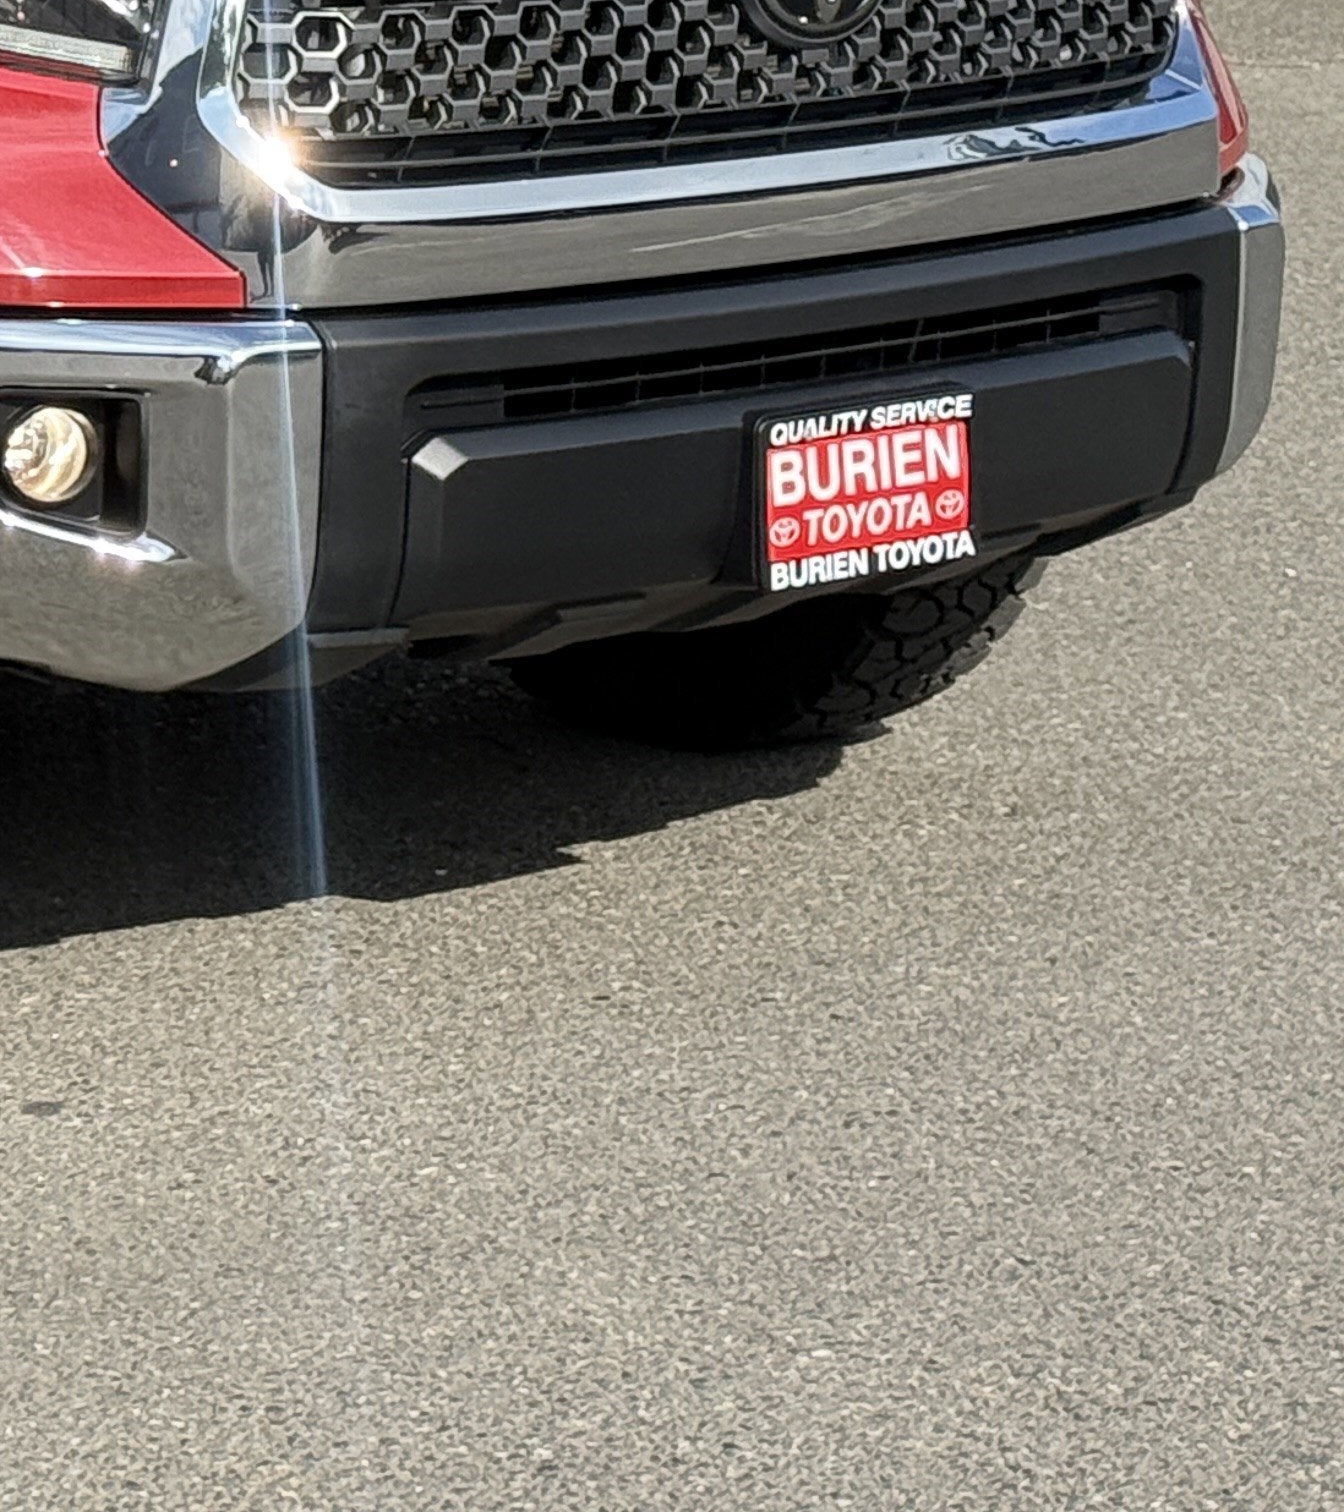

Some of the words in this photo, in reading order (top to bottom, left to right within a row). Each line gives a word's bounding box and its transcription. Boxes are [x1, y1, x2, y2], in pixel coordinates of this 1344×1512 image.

[770, 409, 867, 447] QUALITY
[770, 424, 961, 507] BURIEN
[803, 491, 932, 546] TOYOTA
[771, 548, 869, 591] BURIEN
[873, 530, 976, 572] TOYOTA
